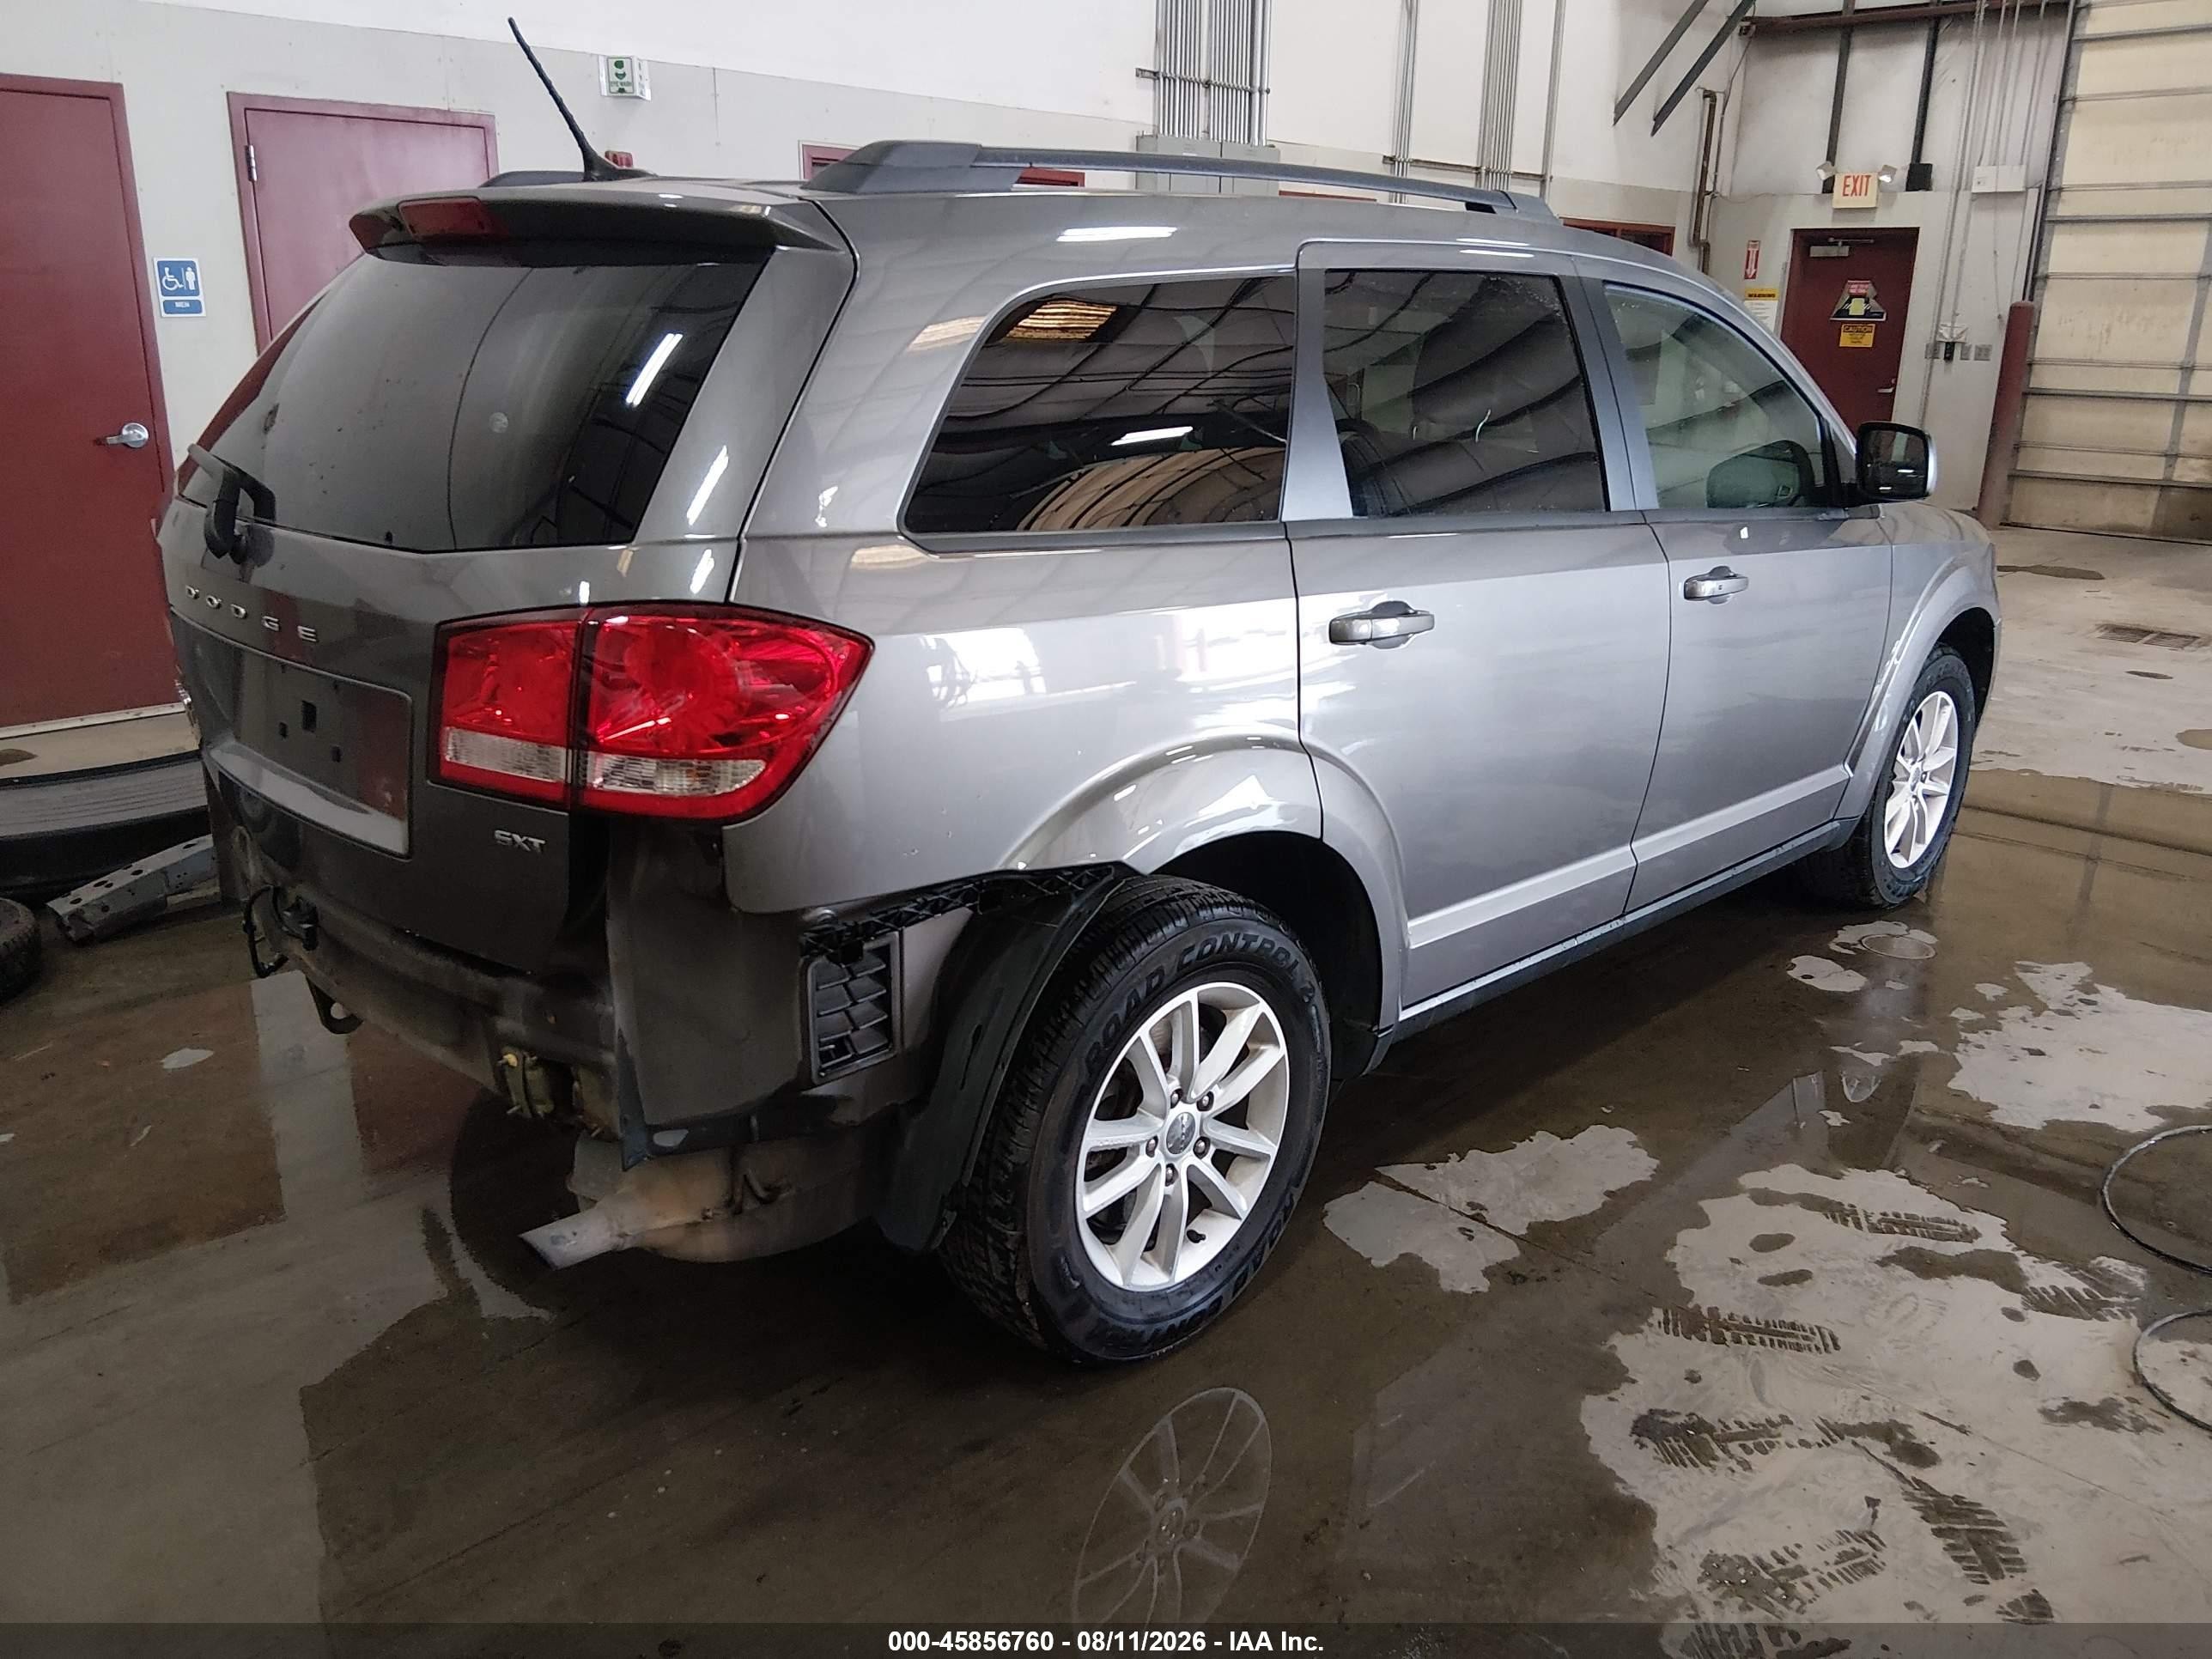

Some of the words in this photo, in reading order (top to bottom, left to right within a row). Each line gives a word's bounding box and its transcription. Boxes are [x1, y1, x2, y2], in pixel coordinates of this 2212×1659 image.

[1842, 174, 1872, 197] EXIT
[185, 585, 317, 642] DODGE
[495, 830, 545, 852] SXT
[1085, 964, 1165, 1073] ROAD
[1177, 932, 1300, 975] CONTROL
